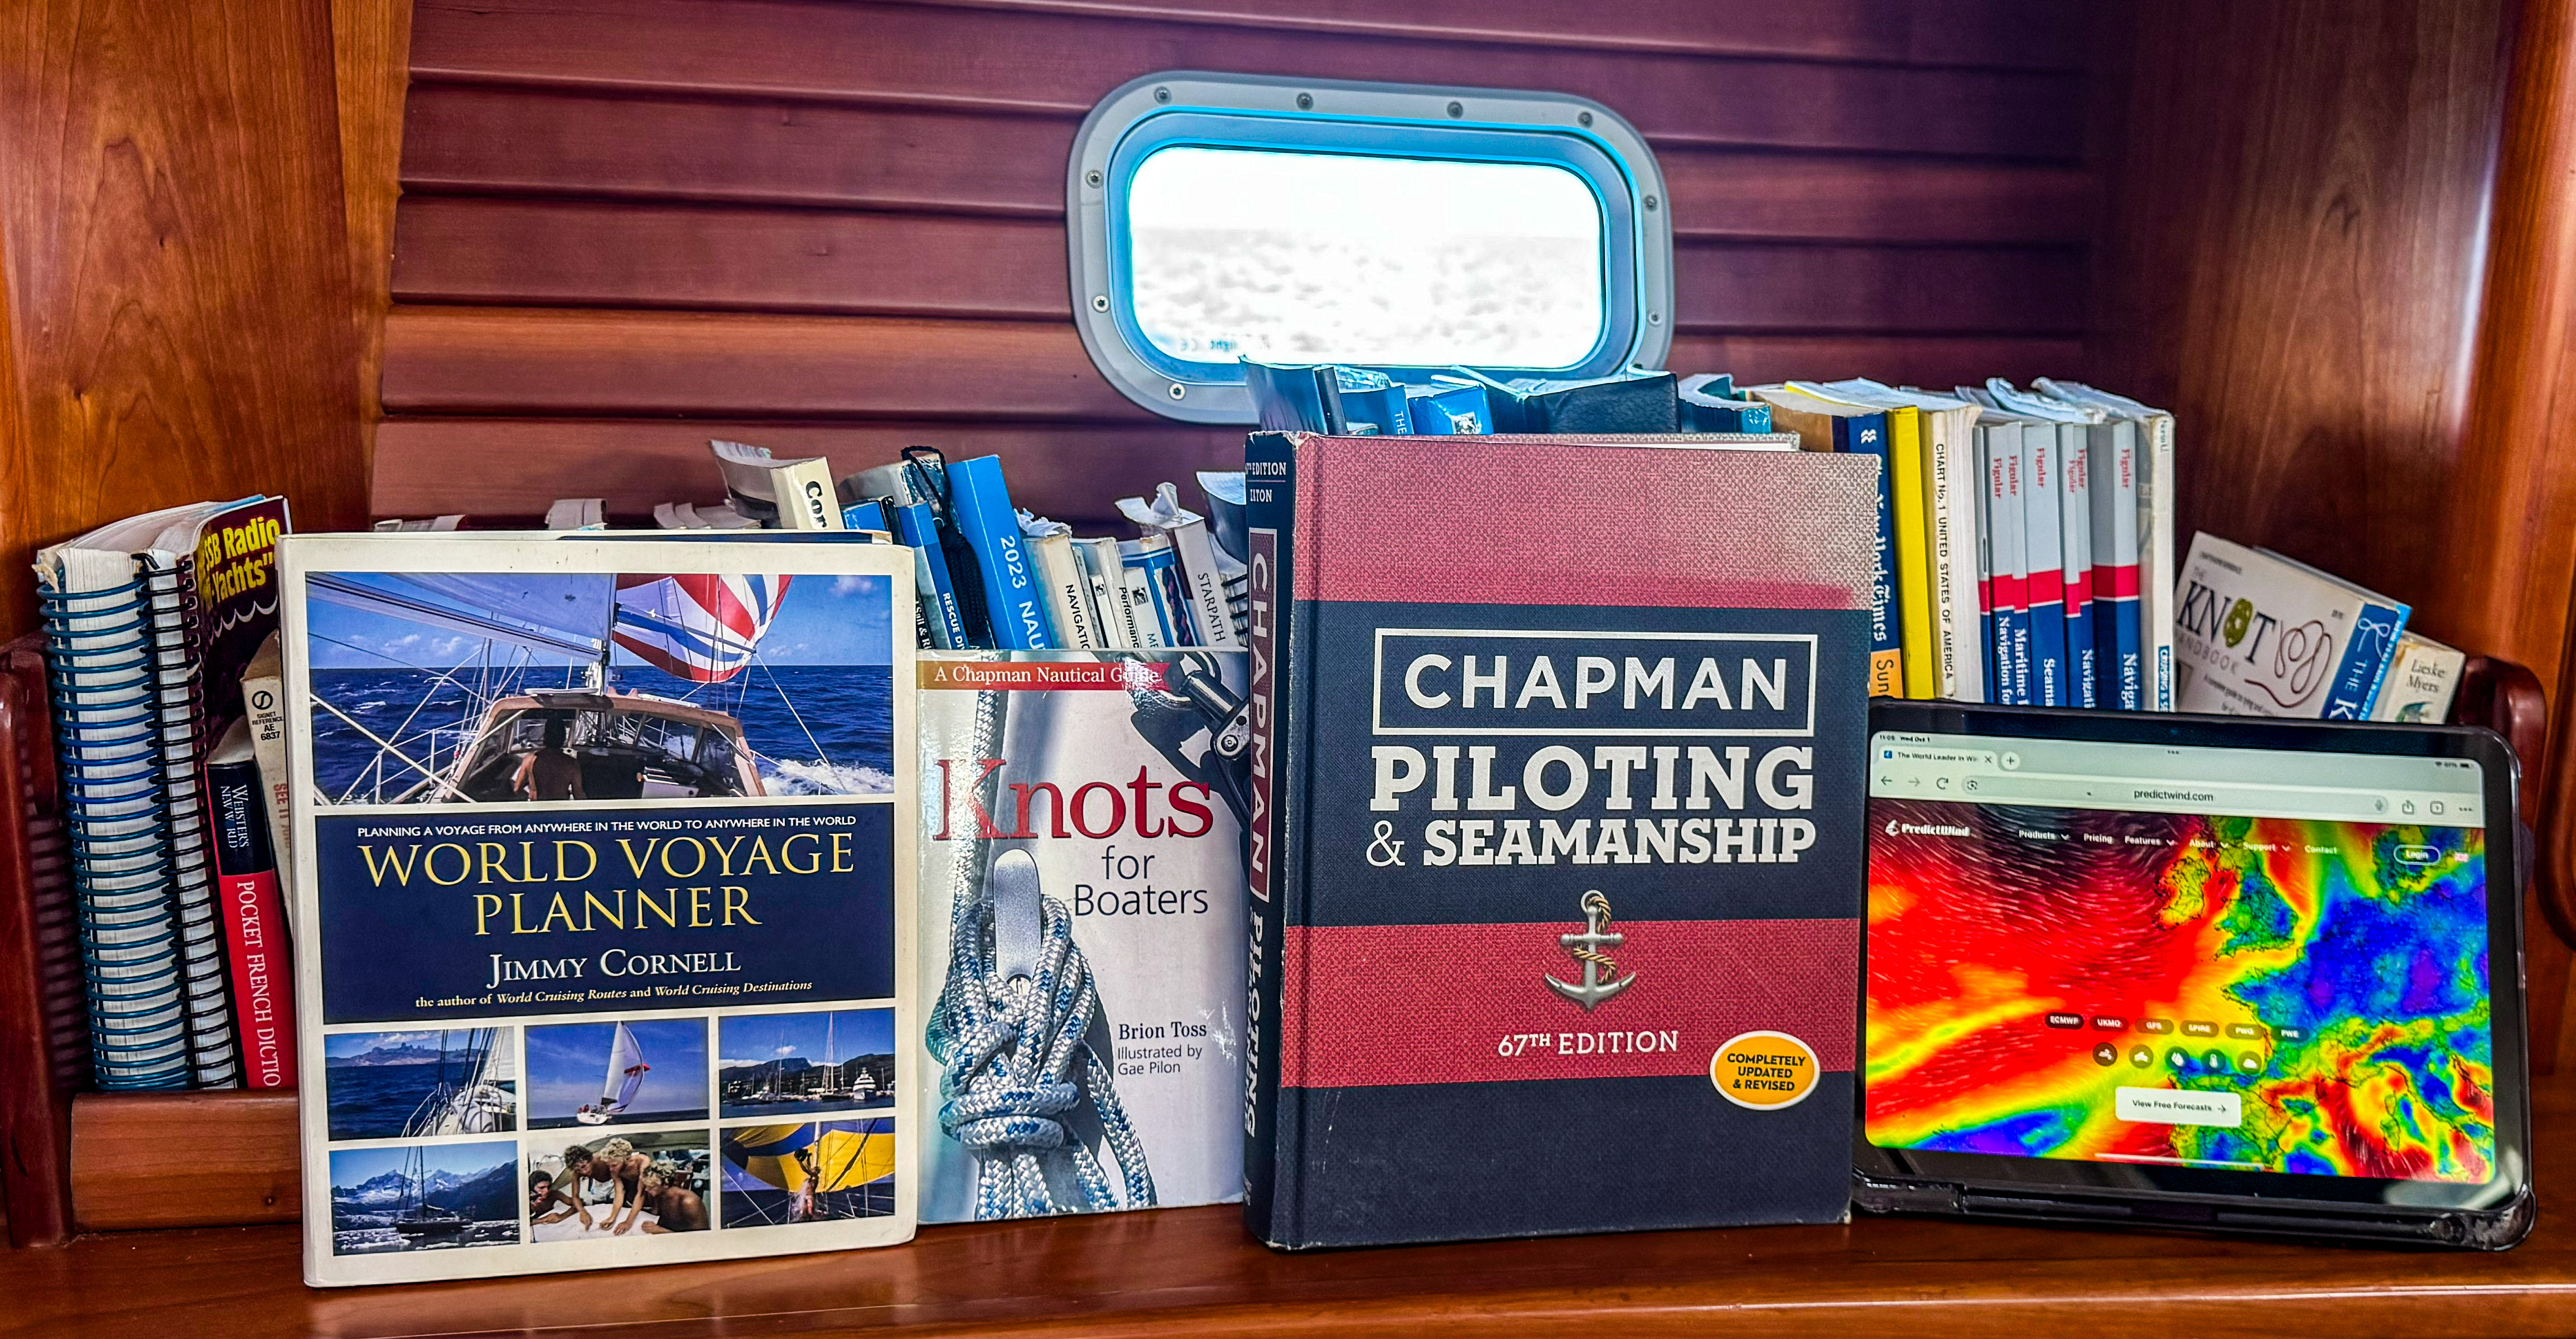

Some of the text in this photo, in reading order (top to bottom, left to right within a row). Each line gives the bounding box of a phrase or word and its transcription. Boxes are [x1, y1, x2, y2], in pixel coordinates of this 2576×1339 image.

[1395, 411, 1407, 435] THE
[1936, 444, 1945, 481] CHART
[223, 516, 281, 560] Radio
[1938, 517, 1947, 557] UNITED
[1000, 535, 1046, 649] 2023 NAU
[1940, 563, 1950, 604] STATES
[943, 592, 961, 633] RESCUE
[1198, 572, 1226, 642] STARPATH
[1873, 584, 1891, 642] Times
[1942, 609, 1950, 624] OF
[2177, 580, 2275, 666] KNOT
[918, 627, 927, 636] &
[1943, 630, 1953, 680] AMERICA
[1998, 616, 2013, 686] Navigation
[2014, 628, 2029, 697] Maritime
[935, 666, 1159, 685] A Chapman Nautical Guide
[1404, 653, 1787, 710] CHAPMAN
[1876, 659, 1894, 692] Sun
[2345, 659, 2368, 692] THE
[2406, 676, 2439, 693] Myers
[1252, 552, 1268, 874] CHAPMAN
[261, 731, 281, 741] 6837
[1369, 745, 1814, 811] PILOTING
[2134, 788, 2213, 802] predictwind.com
[220, 786, 233, 809] NEW
[933, 759, 1214, 841] Knots
[231, 784, 249, 847] WEBSTER'S
[358, 816, 856, 837] PLANNING A VOYAGE FROM ANYWHERE IN THE WORLD TO ANYWHERE IN THE WORLD
[1901, 822, 1971, 837] PredictWind
[1366, 817, 1816, 867] & SEAMANSHIP
[2018, 829, 2056, 840] Products
[2083, 832, 2113, 845] Pricing
[2124, 835, 2162, 846] Features
[2243, 841, 2277, 852] Support
[2304, 844, 2338, 855] Contact
[2405, 850, 2429, 860] Login
[357, 832, 855, 887] WORLD VOYAGE
[1101, 845, 1155, 880] for
[472, 885, 763, 936] PLANNER
[1074, 883, 1209, 917] Boaters
[237, 880, 282, 1087] POCKET FRENCH DICTIO
[486, 948, 742, 989] JIMMY CORNELL
[415, 980, 813, 1008] the author of World Cruising Routes and World Cruising Destinations
[1118, 1021, 1207, 1041] Brion Toss
[1247, 911, 1263, 1138] PILOTING
[1117, 1044, 1203, 1060] Illustrated by
[1498, 1030, 1678, 1057] 67TH EDITION
[1727, 1052, 1806, 1067] COMPLETELY
[1118, 1061, 1181, 1076] Gae Pilon
[1733, 1079, 1795, 1091] & REVISED
[1737, 1066, 1793, 1078] UPDATED
[2132, 1100, 2213, 1112] View Free Forecasts
